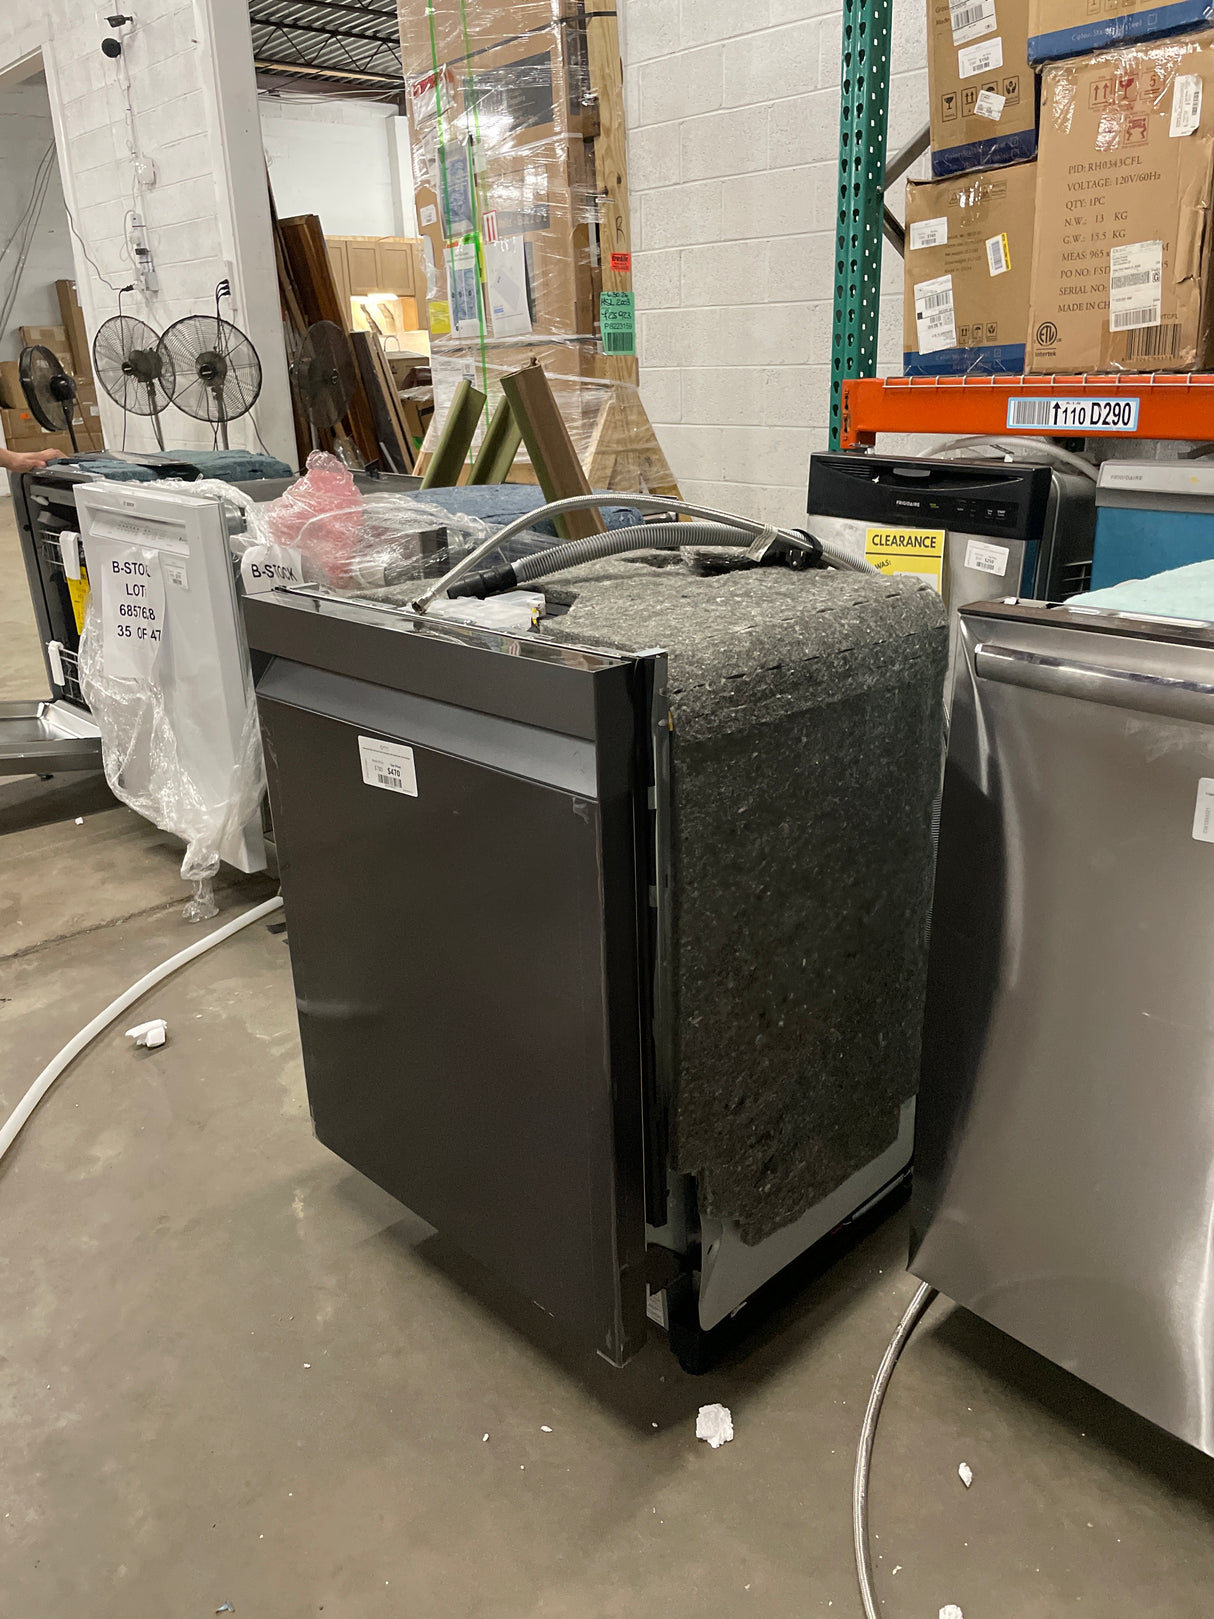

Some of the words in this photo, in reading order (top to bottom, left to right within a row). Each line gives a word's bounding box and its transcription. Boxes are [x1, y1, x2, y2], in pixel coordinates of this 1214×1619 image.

[1068, 164, 1086, 174] PID:
[1088, 155, 1143, 172] RH0343CFL
[1115, 171, 1161, 186] 120V/60Hz
[1065, 199, 1086, 211] QTY:
[1089, 196, 1105, 206] 1PC
[1095, 214, 1105, 223] 13
[1114, 211, 1128, 221] KG
[1112, 229, 1126, 239] KG
[1089, 249, 1104, 259] 965
[1060, 270, 1073, 279] PO
[1058, 286, 1088, 296] SERIAL
[1090, 284, 1107, 294] NO:
[1057, 303, 1083, 313] MADE
[1085, 302, 1095, 311] IN
[1097, 301, 1110, 310] CH
[1062, 407, 1086, 425] 110
[1090, 402, 1132, 426] D290
[896, 500, 920, 508] FRIGIDAIRE
[872, 534, 937, 549] CLEARANCE
[875, 559, 891, 570] WAS:
[251, 564, 298, 582] B-STOCK
[117, 624, 132, 638] 35
[137, 626, 148, 640] OF
[150, 629, 162, 642] 47
[387, 767, 401, 777] $470
